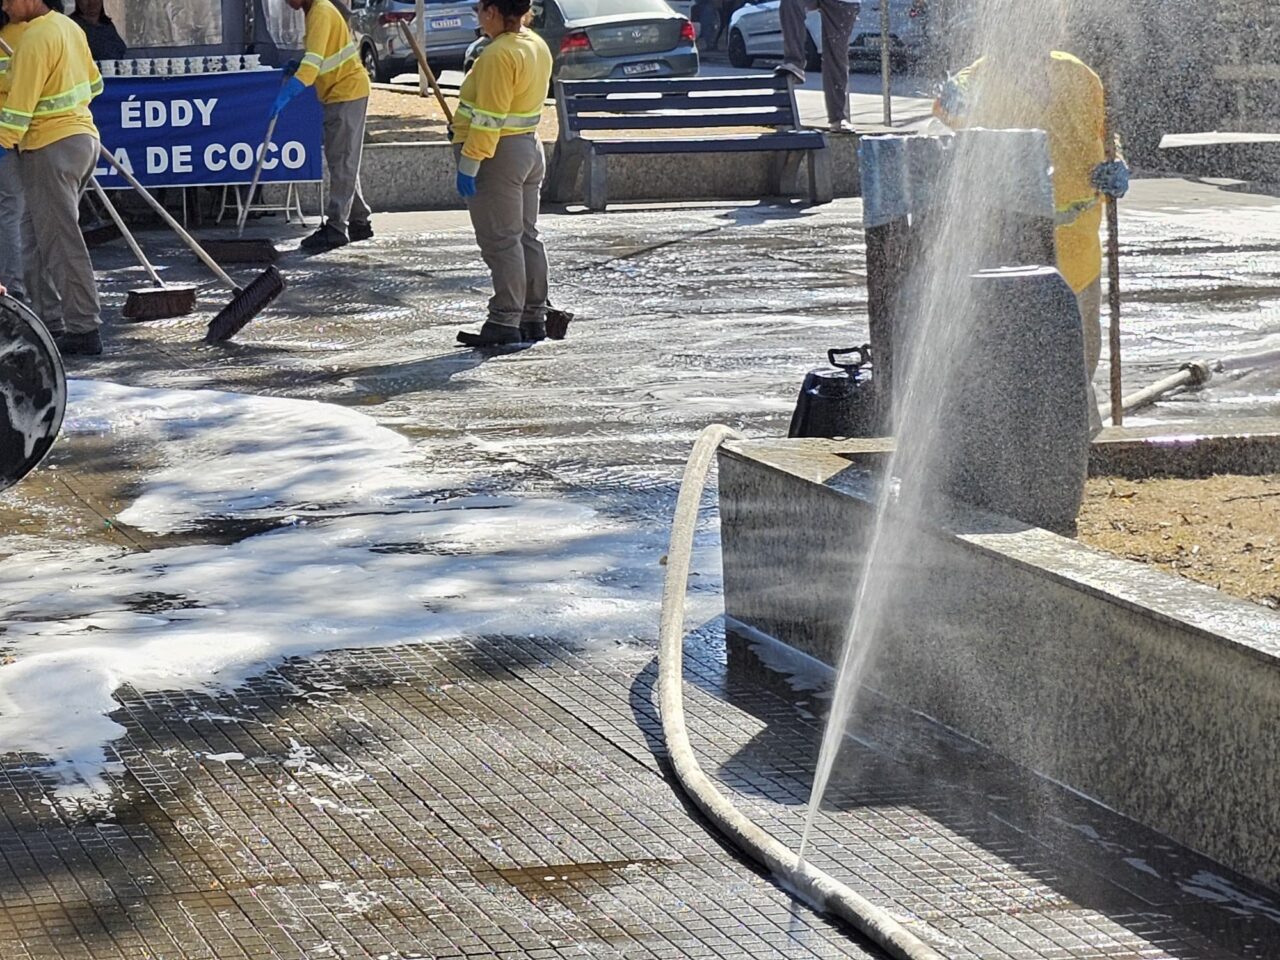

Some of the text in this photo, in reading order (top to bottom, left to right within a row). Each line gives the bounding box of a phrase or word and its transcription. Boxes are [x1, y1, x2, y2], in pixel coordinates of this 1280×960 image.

[121, 95, 218, 129] ÉDDY
[146, 145, 192, 174] DE
[203, 141, 306, 172] COCO
